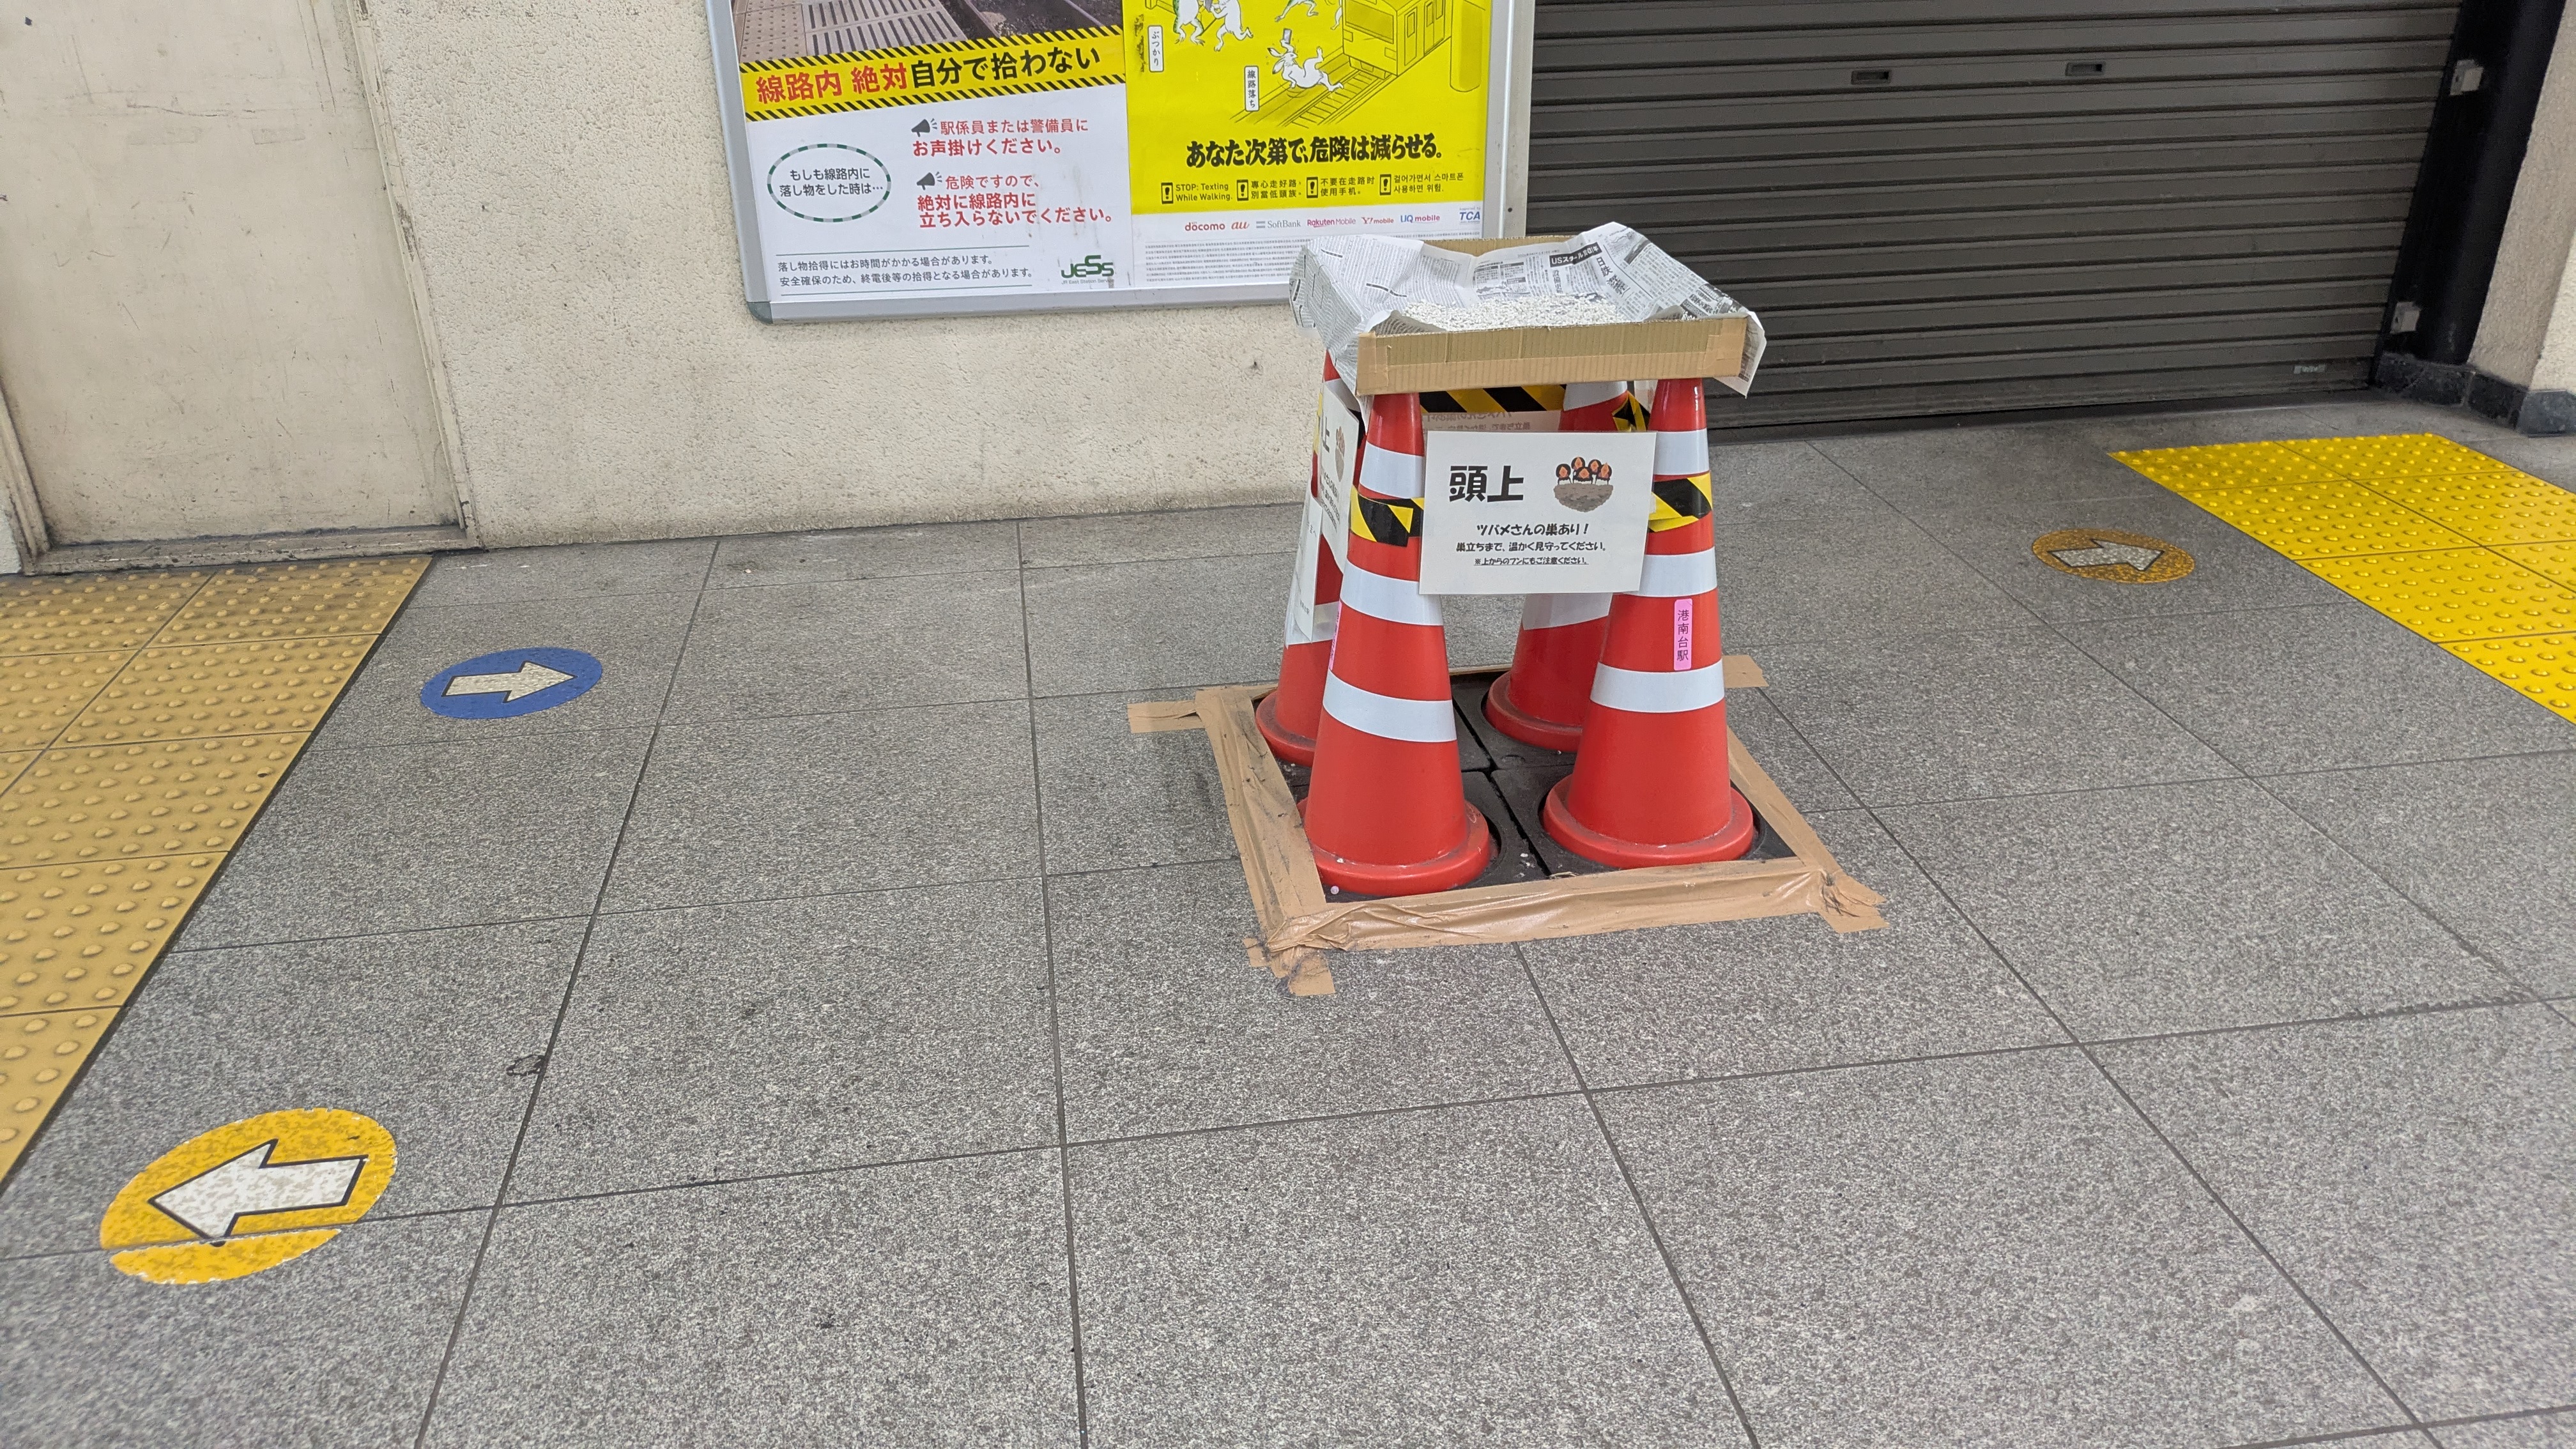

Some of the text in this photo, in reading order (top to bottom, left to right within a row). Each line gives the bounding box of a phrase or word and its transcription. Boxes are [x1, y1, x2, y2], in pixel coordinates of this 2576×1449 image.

[1152, 31, 1160, 66] ぶつかり
[756, 70, 843, 104] 線路内
[1247, 70, 1256, 108] 線路落ち
[940, 118, 1088, 135] 駅係員または警備員に
[912, 137, 1062, 157] お声掛けください。
[1186, 133, 1442, 168] あなた次第で、危険は減らせる。
[790, 167, 870, 181] もしも線路内に
[1393, 172, 1464, 183] 걸어가면서 스마트폰
[946, 174, 1039, 190] 危険ですので、
[1200, 182, 1229, 191] Texting
[1321, 176, 1375, 186] 不要在走路时
[1321, 187, 1361, 197] 使用手机。
[1393, 183, 1445, 194] 사용하면 위험.
[917, 192, 1036, 211] 絶対に線路内に
[1176, 193, 1233, 202] While Walking.
[919, 206, 1112, 228] 立ち入らないでください。
[1307, 218, 1335, 227] Rakuten
[1400, 214, 1441, 223] UQ mobile
[1459, 211, 1481, 221] TCA
[1185, 222, 1225, 231] docomo
[1231, 221, 1250, 229] au
[1268, 219, 1301, 229] SoftBank
[778, 255, 992, 272] 落し物拾得にはお時間がかかる場合があります。
[779, 268, 1032, 287] 安全確保のため、終電後等の拾得となる場合があります。
[1449, 465, 1524, 503] 頭上
[1476, 523, 1589, 536] ツバメさんの巣あり！
[1456, 542, 1606, 552] 巣立ちまで、温かく見守ってください。
[1676, 609, 1690, 662] 港南台駅
